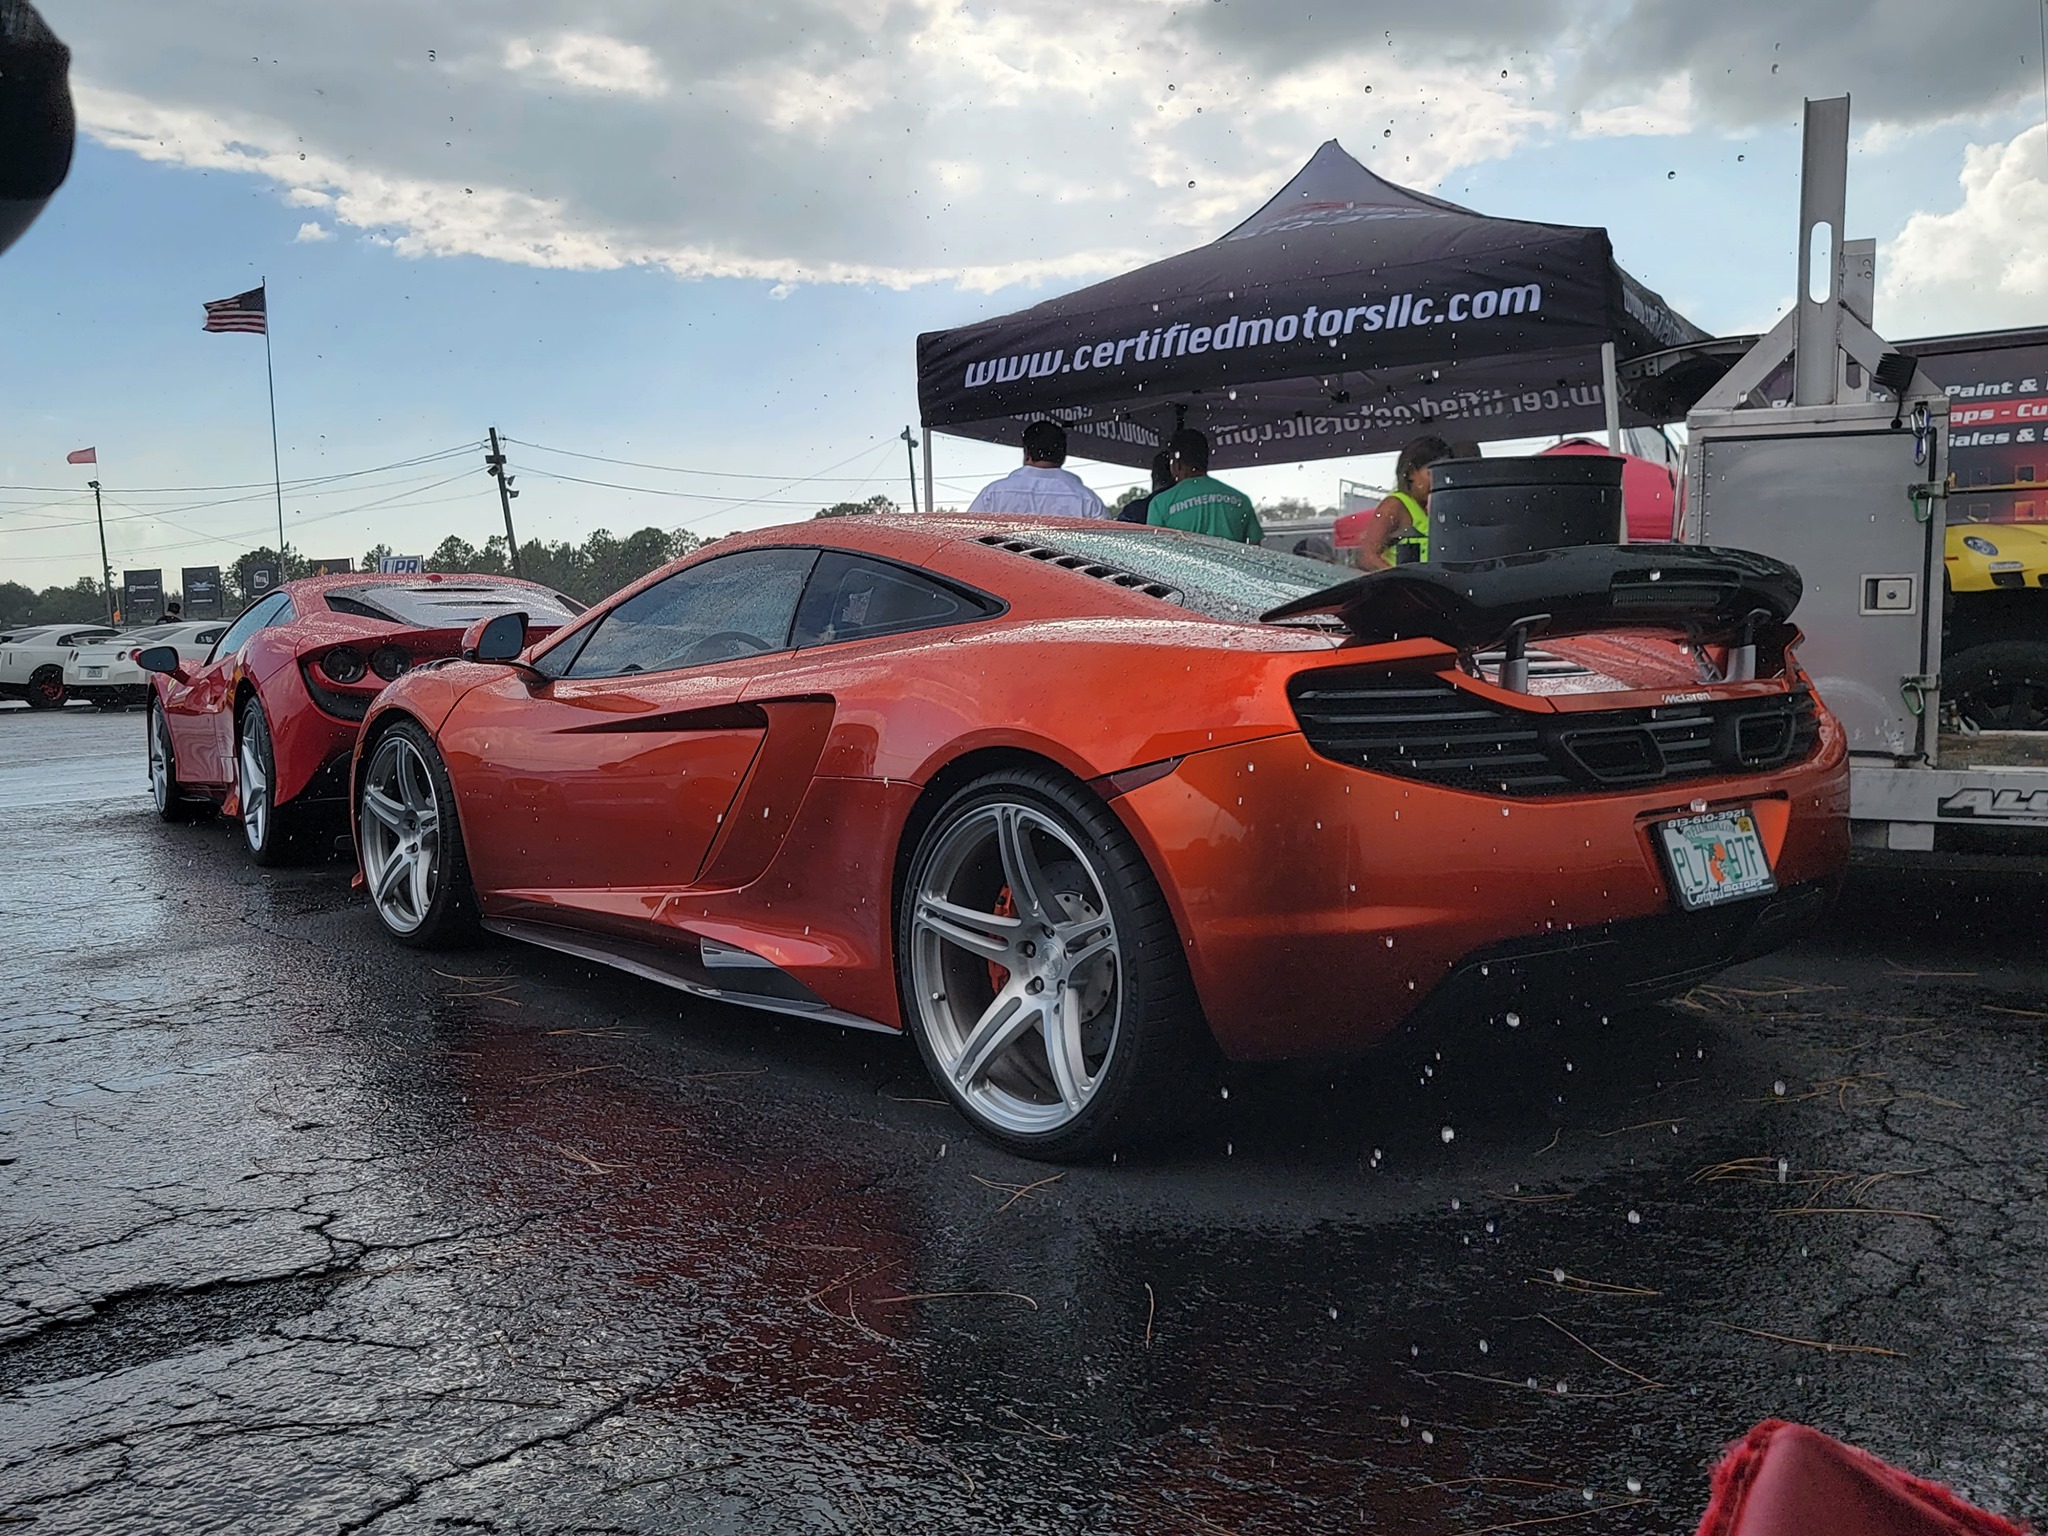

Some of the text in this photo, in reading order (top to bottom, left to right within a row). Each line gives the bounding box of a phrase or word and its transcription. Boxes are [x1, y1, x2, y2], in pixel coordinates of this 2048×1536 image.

[964, 283, 1541, 388] www.certifiedmotorsllc.com
[1945, 381, 2013, 398] Paint
[2019, 378, 2038, 393] &
[1950, 408, 1995, 425] aps
[2017, 403, 2048, 418] Cu
[2016, 428, 2036, 443] &
[1664, 692, 1711, 705] McLaren
[1667, 809, 1745, 829] 813-610-3921
